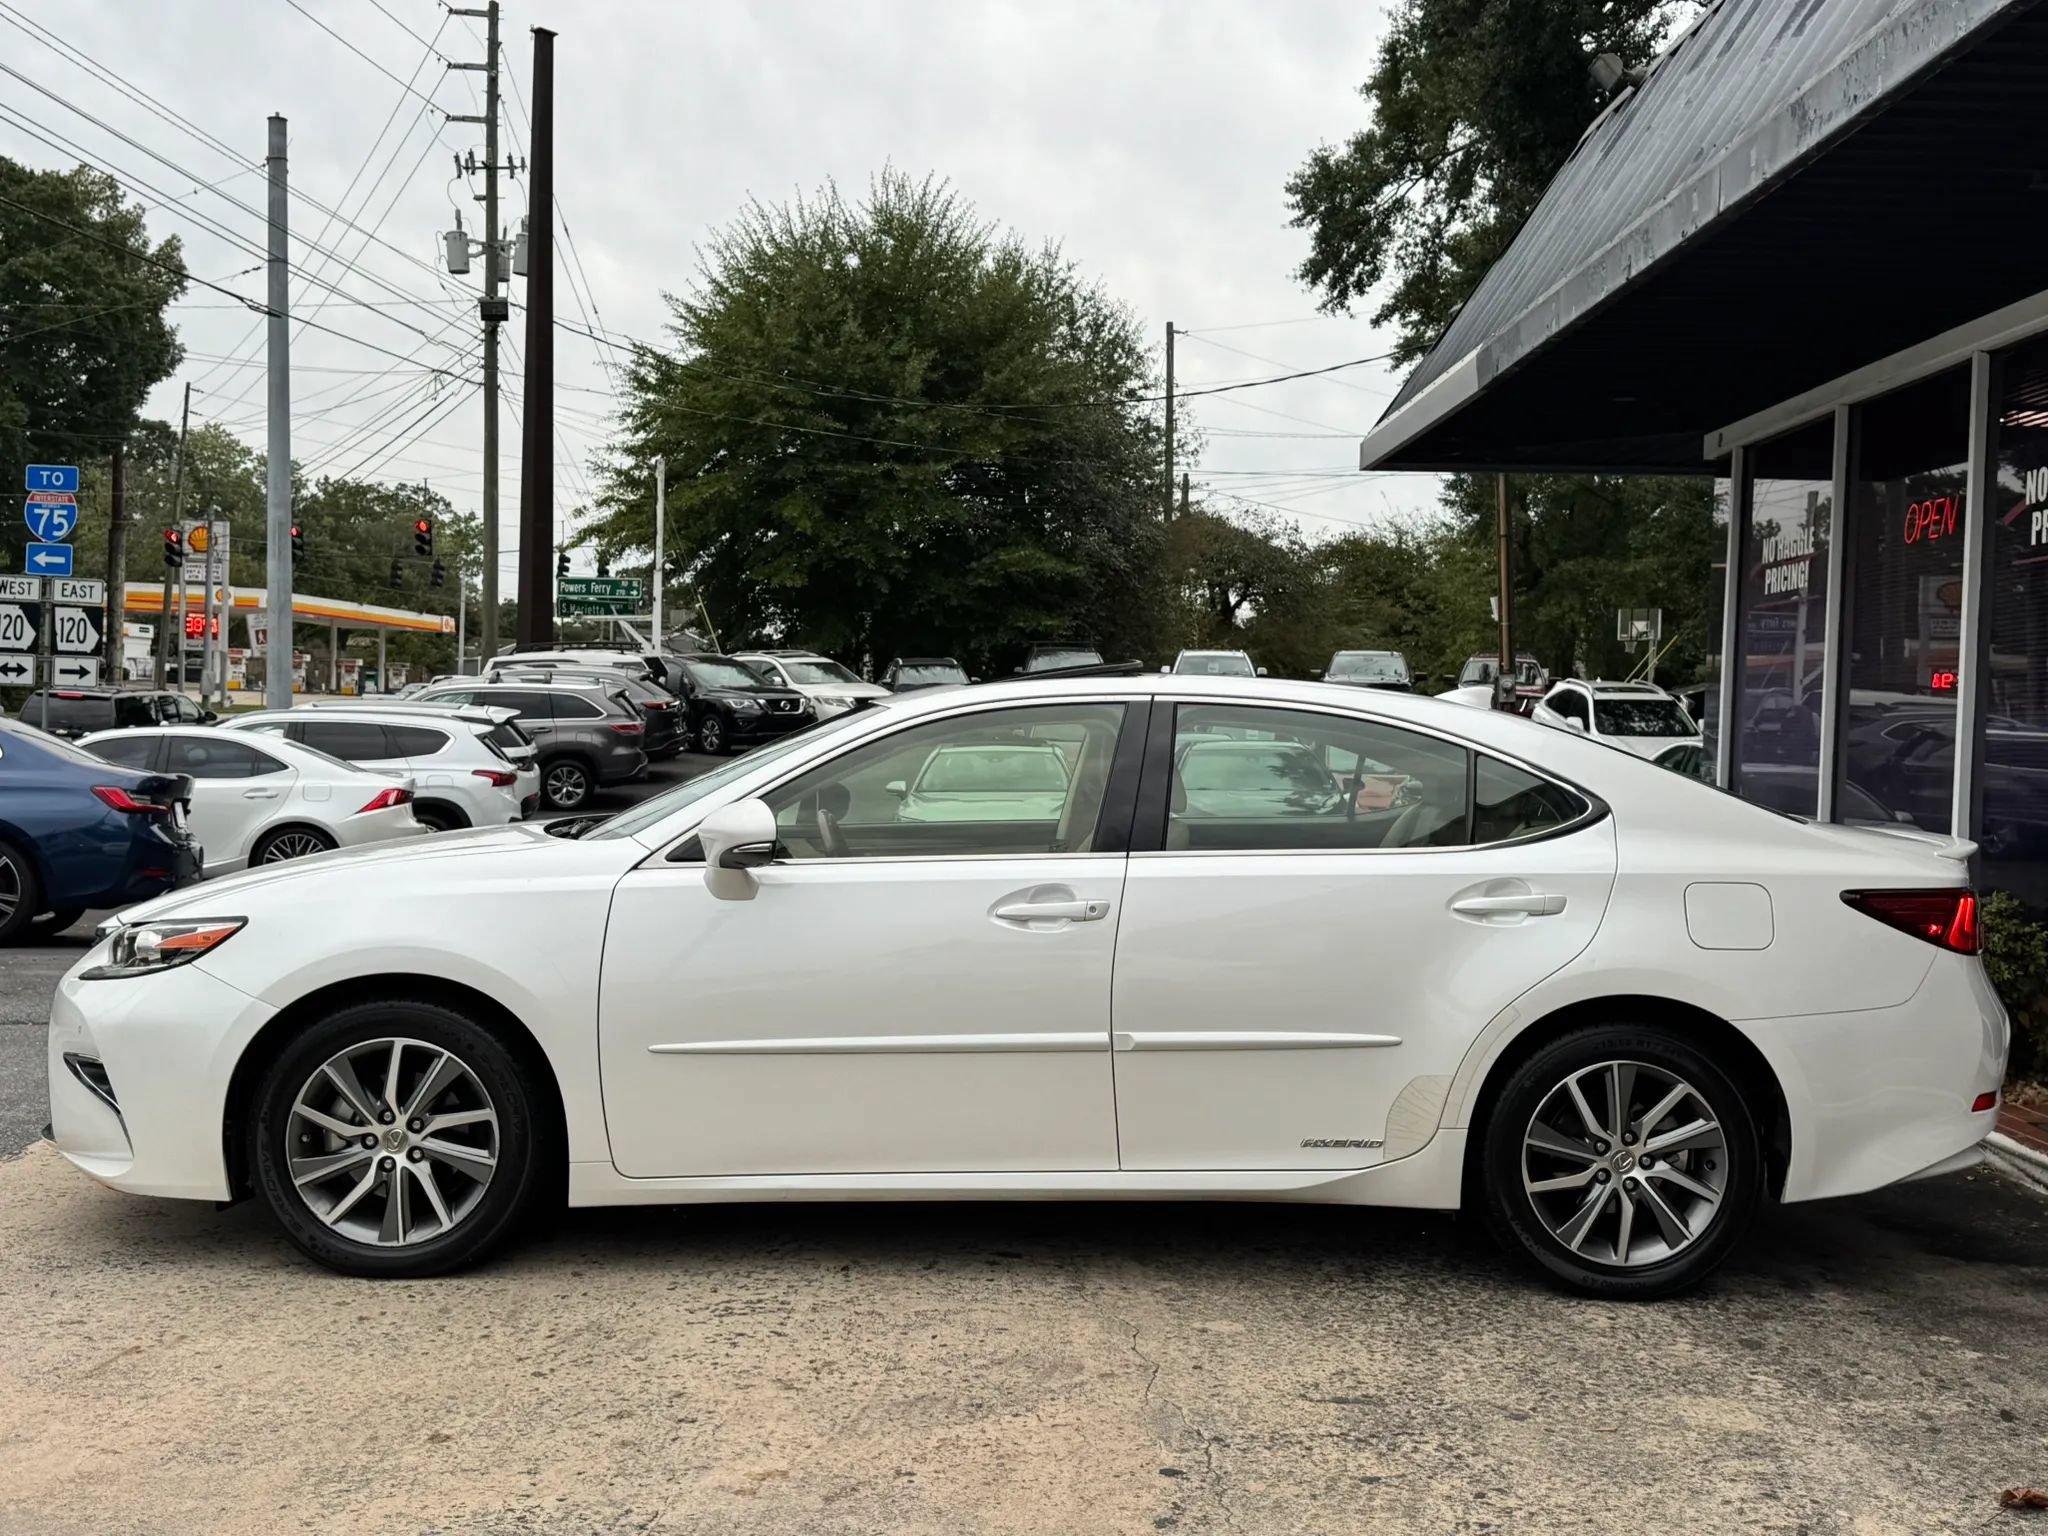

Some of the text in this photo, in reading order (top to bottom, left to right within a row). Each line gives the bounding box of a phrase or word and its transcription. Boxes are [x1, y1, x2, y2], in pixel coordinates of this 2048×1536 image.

[40, 471, 64, 486] TO
[2025, 466, 2048, 506] NO
[33, 508, 69, 537] 75
[1904, 495, 1959, 544] OPEN
[1762, 526, 1815, 564] NO HAGGLE
[0, 580, 33, 596] WEST
[61, 582, 95, 599] EAST
[560, 582, 587, 593] Powers
[591, 582, 611, 595] Ferry
[1764, 560, 1810, 595] PRICING!
[0, 613, 24, 641] 20
[59, 616, 87, 644] 120
[1300, 1139, 1384, 1149] HYBRID
